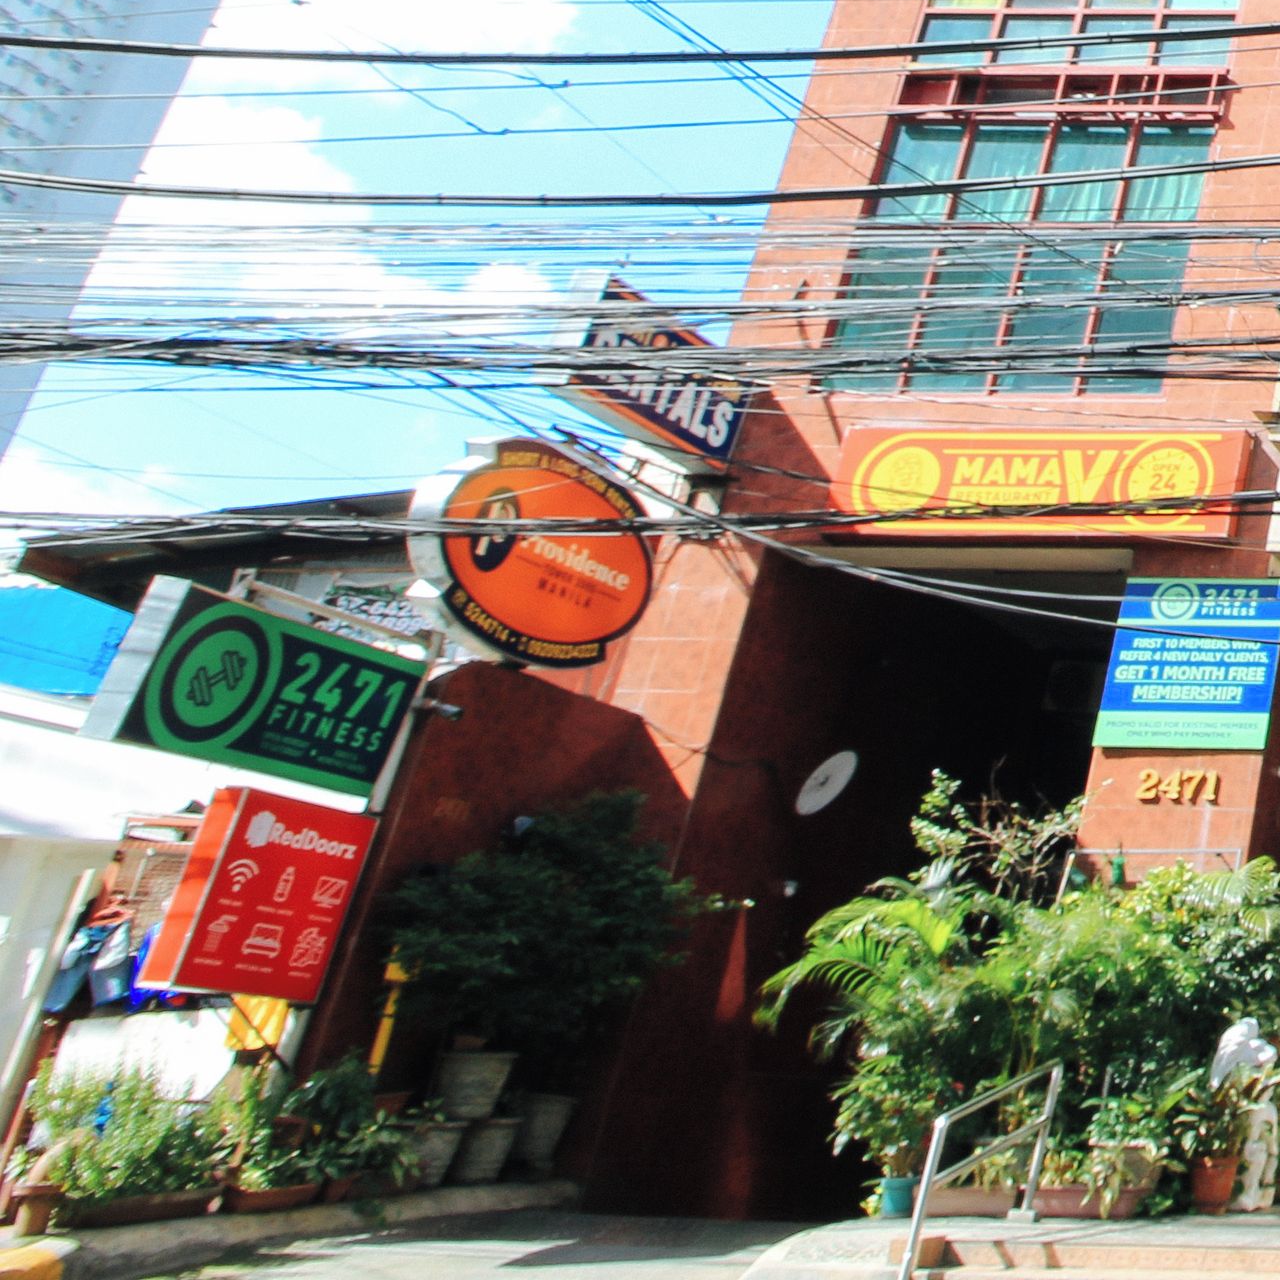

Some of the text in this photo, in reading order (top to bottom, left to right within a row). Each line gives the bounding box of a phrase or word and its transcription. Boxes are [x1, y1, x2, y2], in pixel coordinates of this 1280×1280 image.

[952, 456, 1062, 485] MAMA
[1152, 464, 1182, 473] OPEN
[1150, 474, 1178, 492] 24
[956, 490, 1055, 504] RESTAURANT
[519, 535, 631, 591] Providence
[1201, 607, 1256, 617] FITNESS
[1133, 637, 1162, 650] FIRST
[1165, 638, 1178, 650] 10
[1179, 638, 1231, 650] MEMBERS
[1119, 650, 1152, 662] REFER
[1152, 651, 1161, 663] 4
[1162, 651, 1188, 663] NEW
[1189, 651, 1222, 663] DAILY
[1114, 665, 1148, 680] GET
[1162, 666, 1225, 682] MONTH
[1228, 667, 1266, 682] FREE
[279, 652, 406, 729] 2471
[1132, 685, 1243, 702] MEMBERSHIP!
[267, 704, 384, 752] FITNESS
[1136, 769, 1219, 801] 2471
[268, 822, 357, 859] RedDoorz
